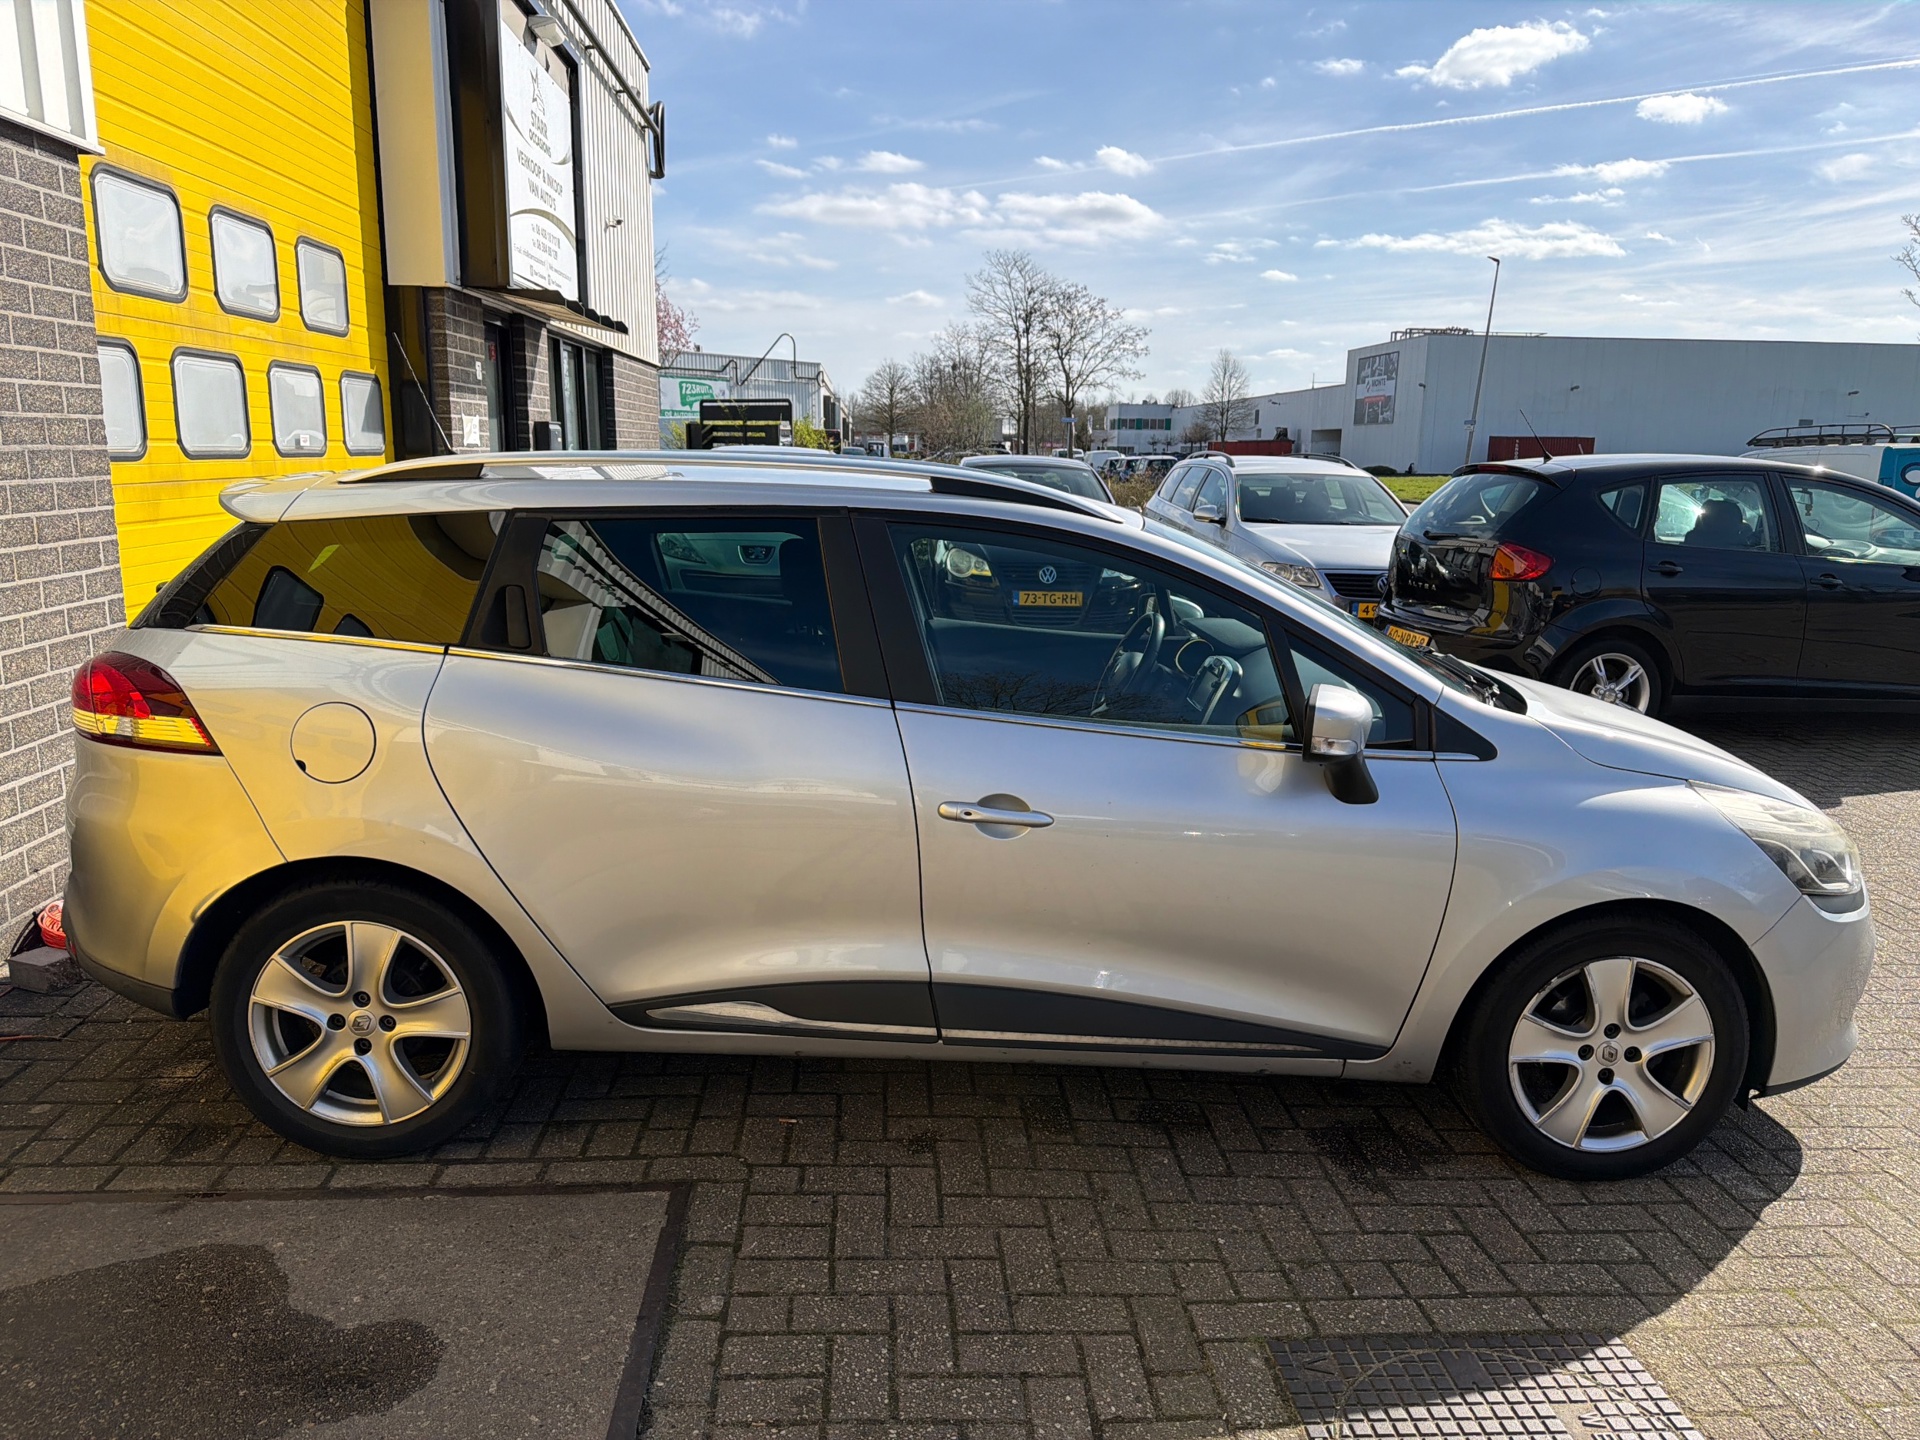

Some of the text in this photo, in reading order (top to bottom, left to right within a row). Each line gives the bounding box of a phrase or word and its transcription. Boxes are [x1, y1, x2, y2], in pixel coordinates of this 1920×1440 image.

[530, 110, 548, 141] STARR
[528, 128, 552, 158] OCCASIONS
[516, 147, 541, 179] VERKOOP
[546, 172, 563, 198] INKOOP
[528, 177, 539, 199] VAN
[1023, 593, 1077, 605] 73-TG-RH
